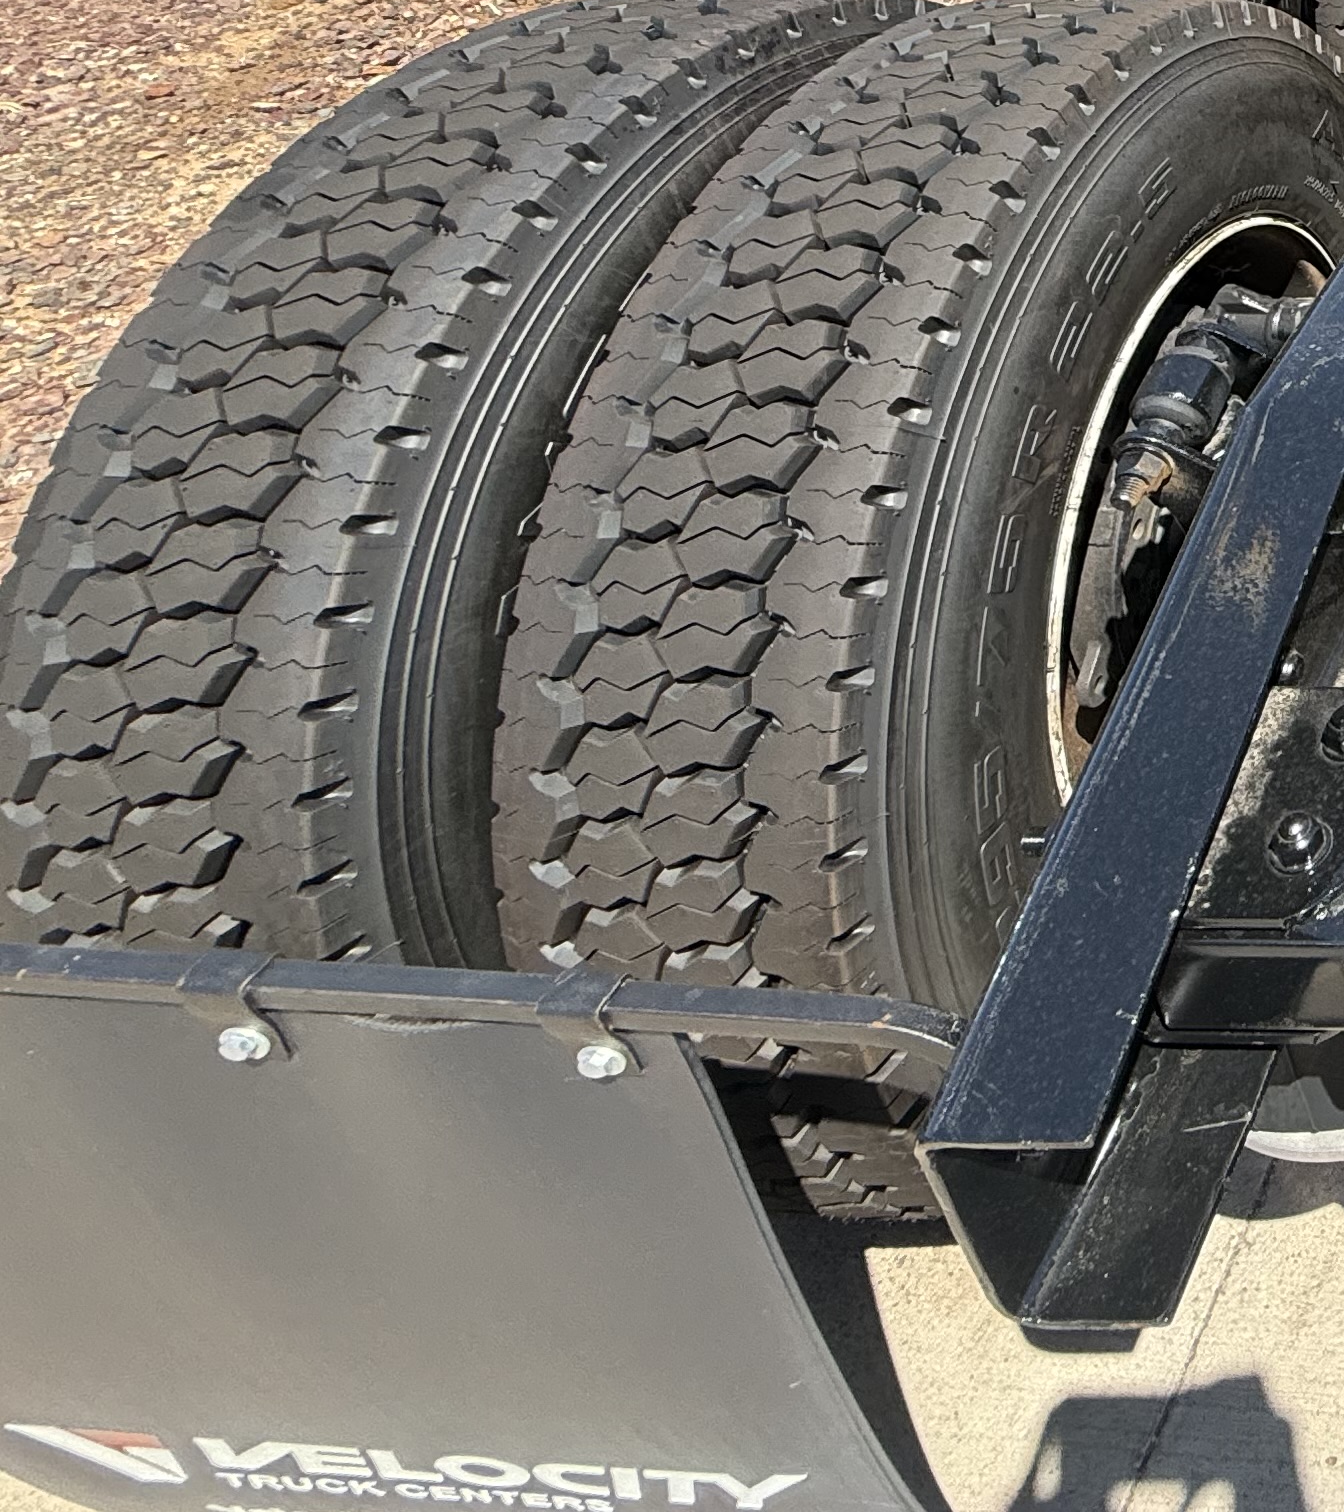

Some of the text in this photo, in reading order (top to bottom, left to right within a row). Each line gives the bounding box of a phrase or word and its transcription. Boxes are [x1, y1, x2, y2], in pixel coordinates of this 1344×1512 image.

[193, 1436, 808, 1510] VELOCITY
[214, 1471, 614, 1512] TRUCK CENTERS
